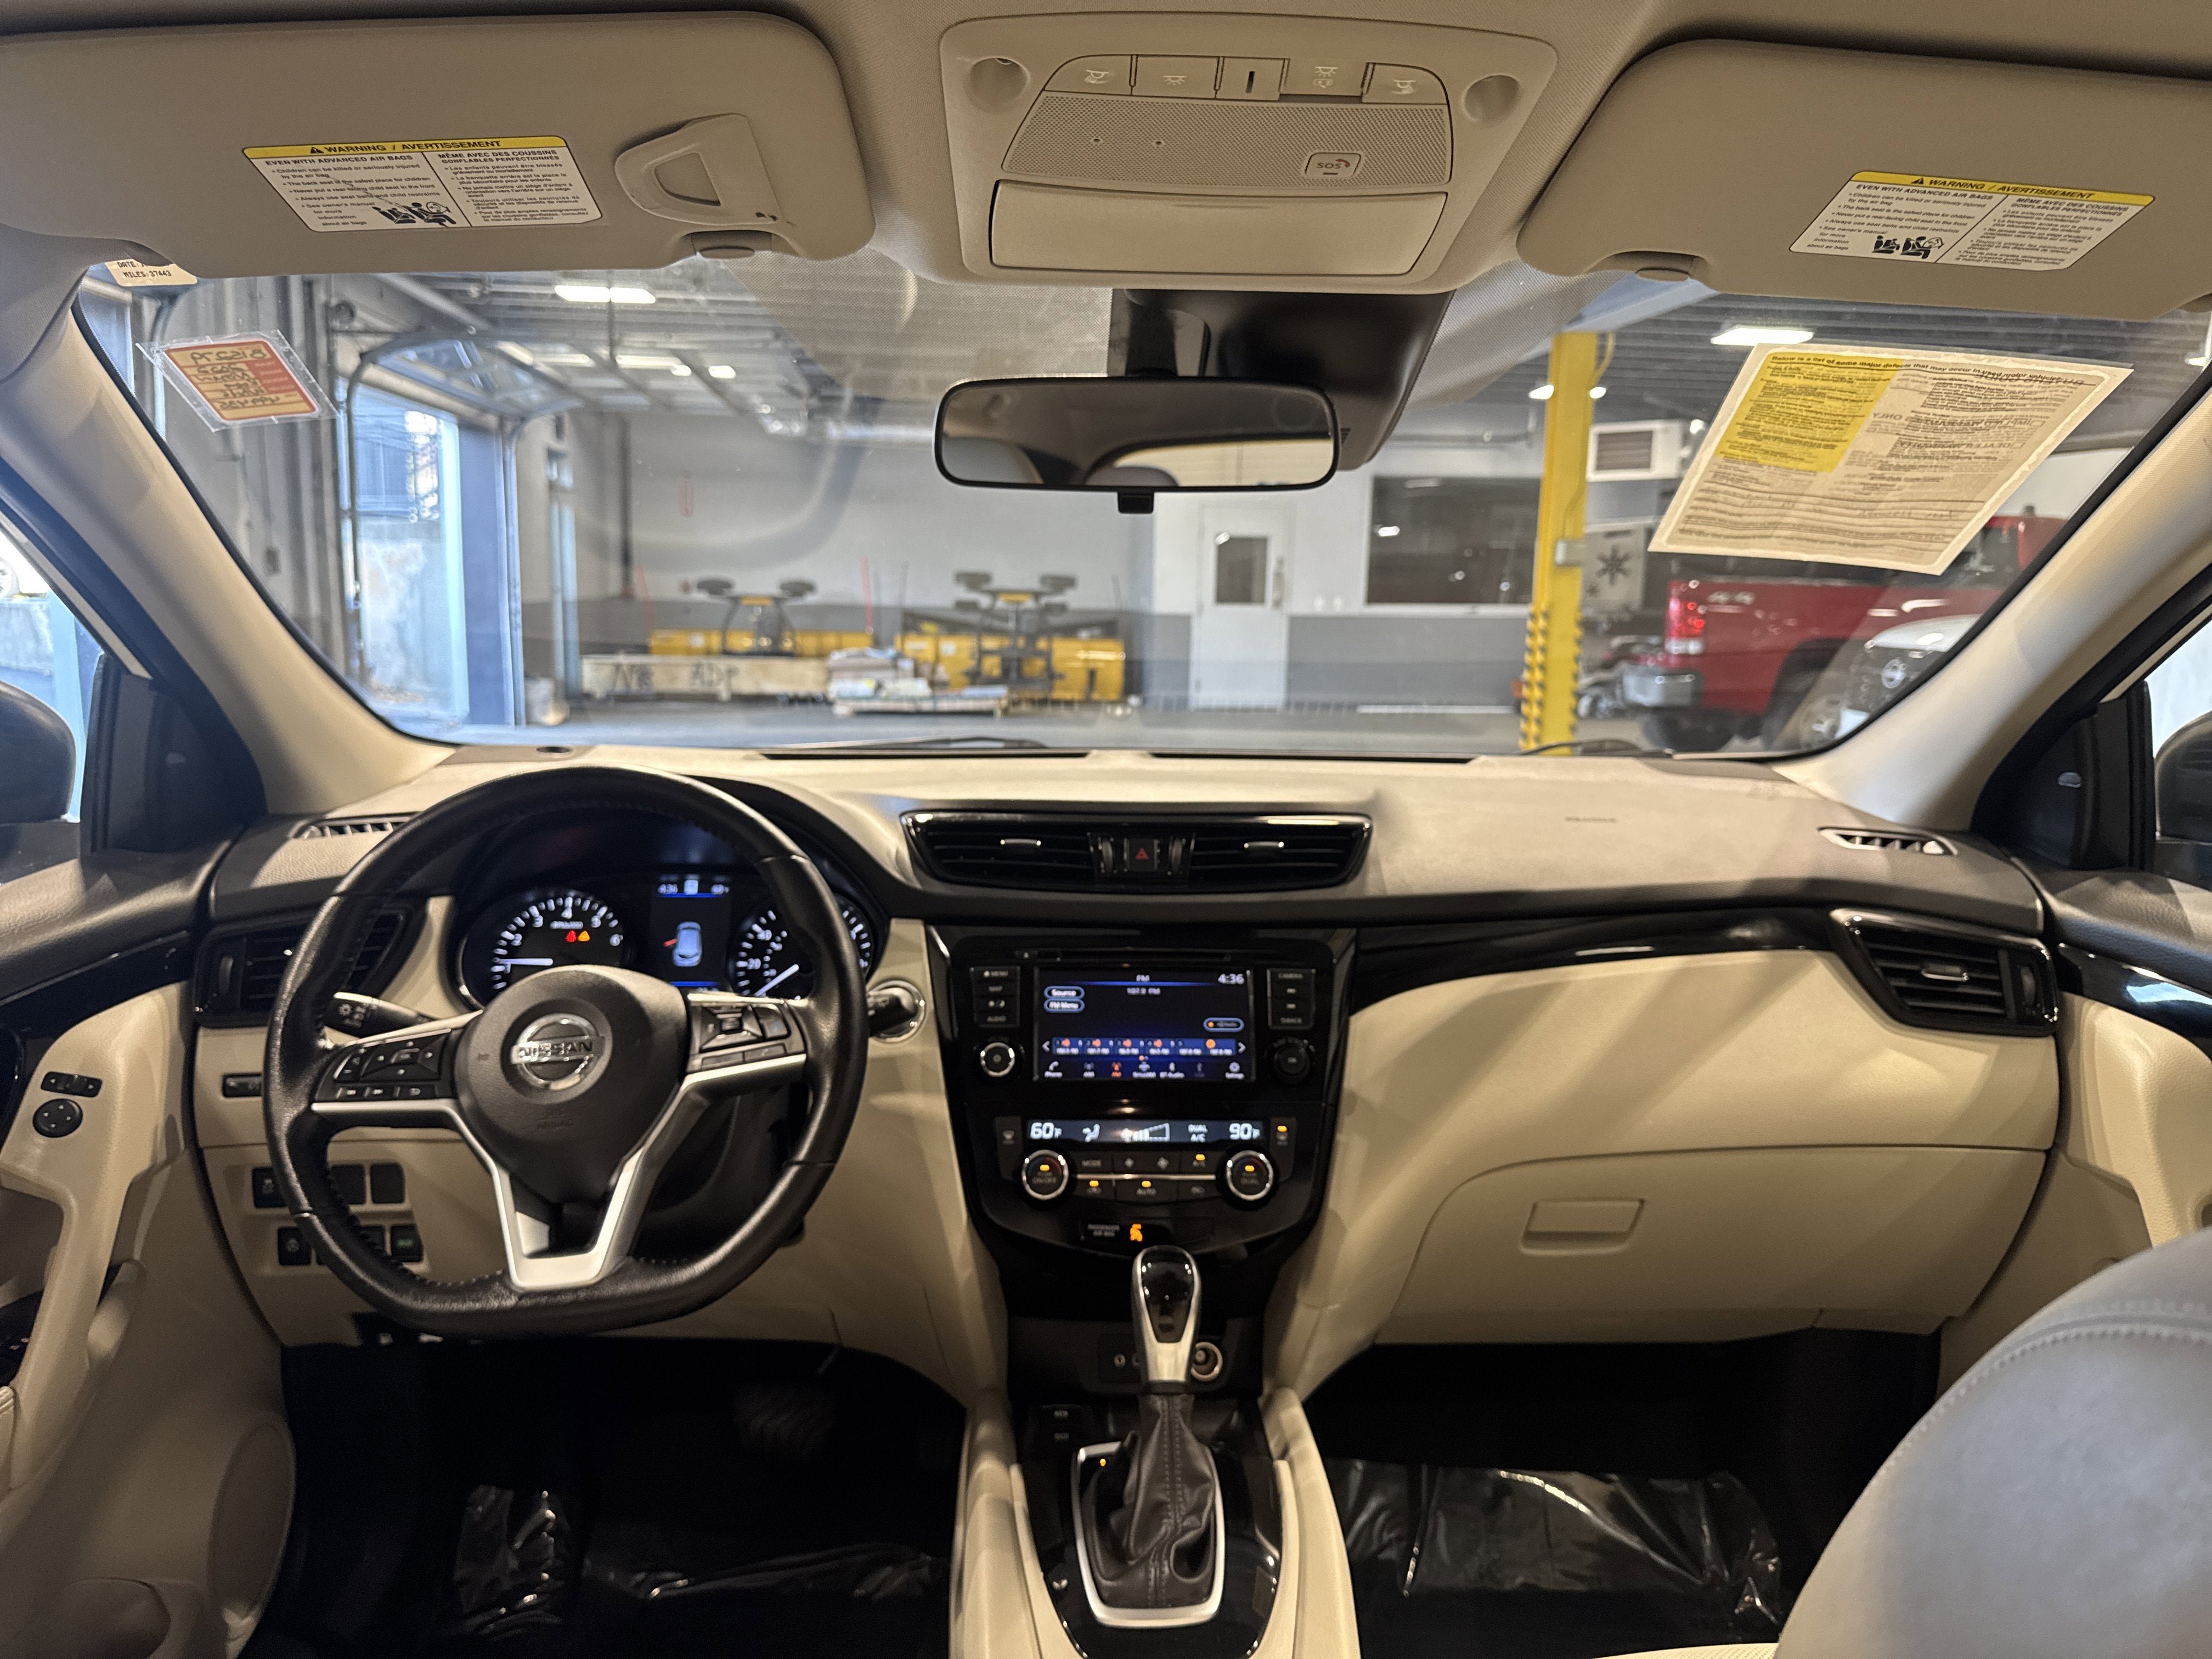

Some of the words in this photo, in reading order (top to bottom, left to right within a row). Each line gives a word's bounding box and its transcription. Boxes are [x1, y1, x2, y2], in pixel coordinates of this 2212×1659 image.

[325, 144, 386, 153] WARNING
[402, 140, 500, 150] AVERTISSEMENT
[1904, 188, 1951, 196] ADVANCED
[1929, 179, 1985, 189] WARNING
[1997, 186, 2095, 199] AVERTISSEMENT
[1217, 973, 1245, 985] 4:36
[518, 1041, 593, 1058] NISSAN
